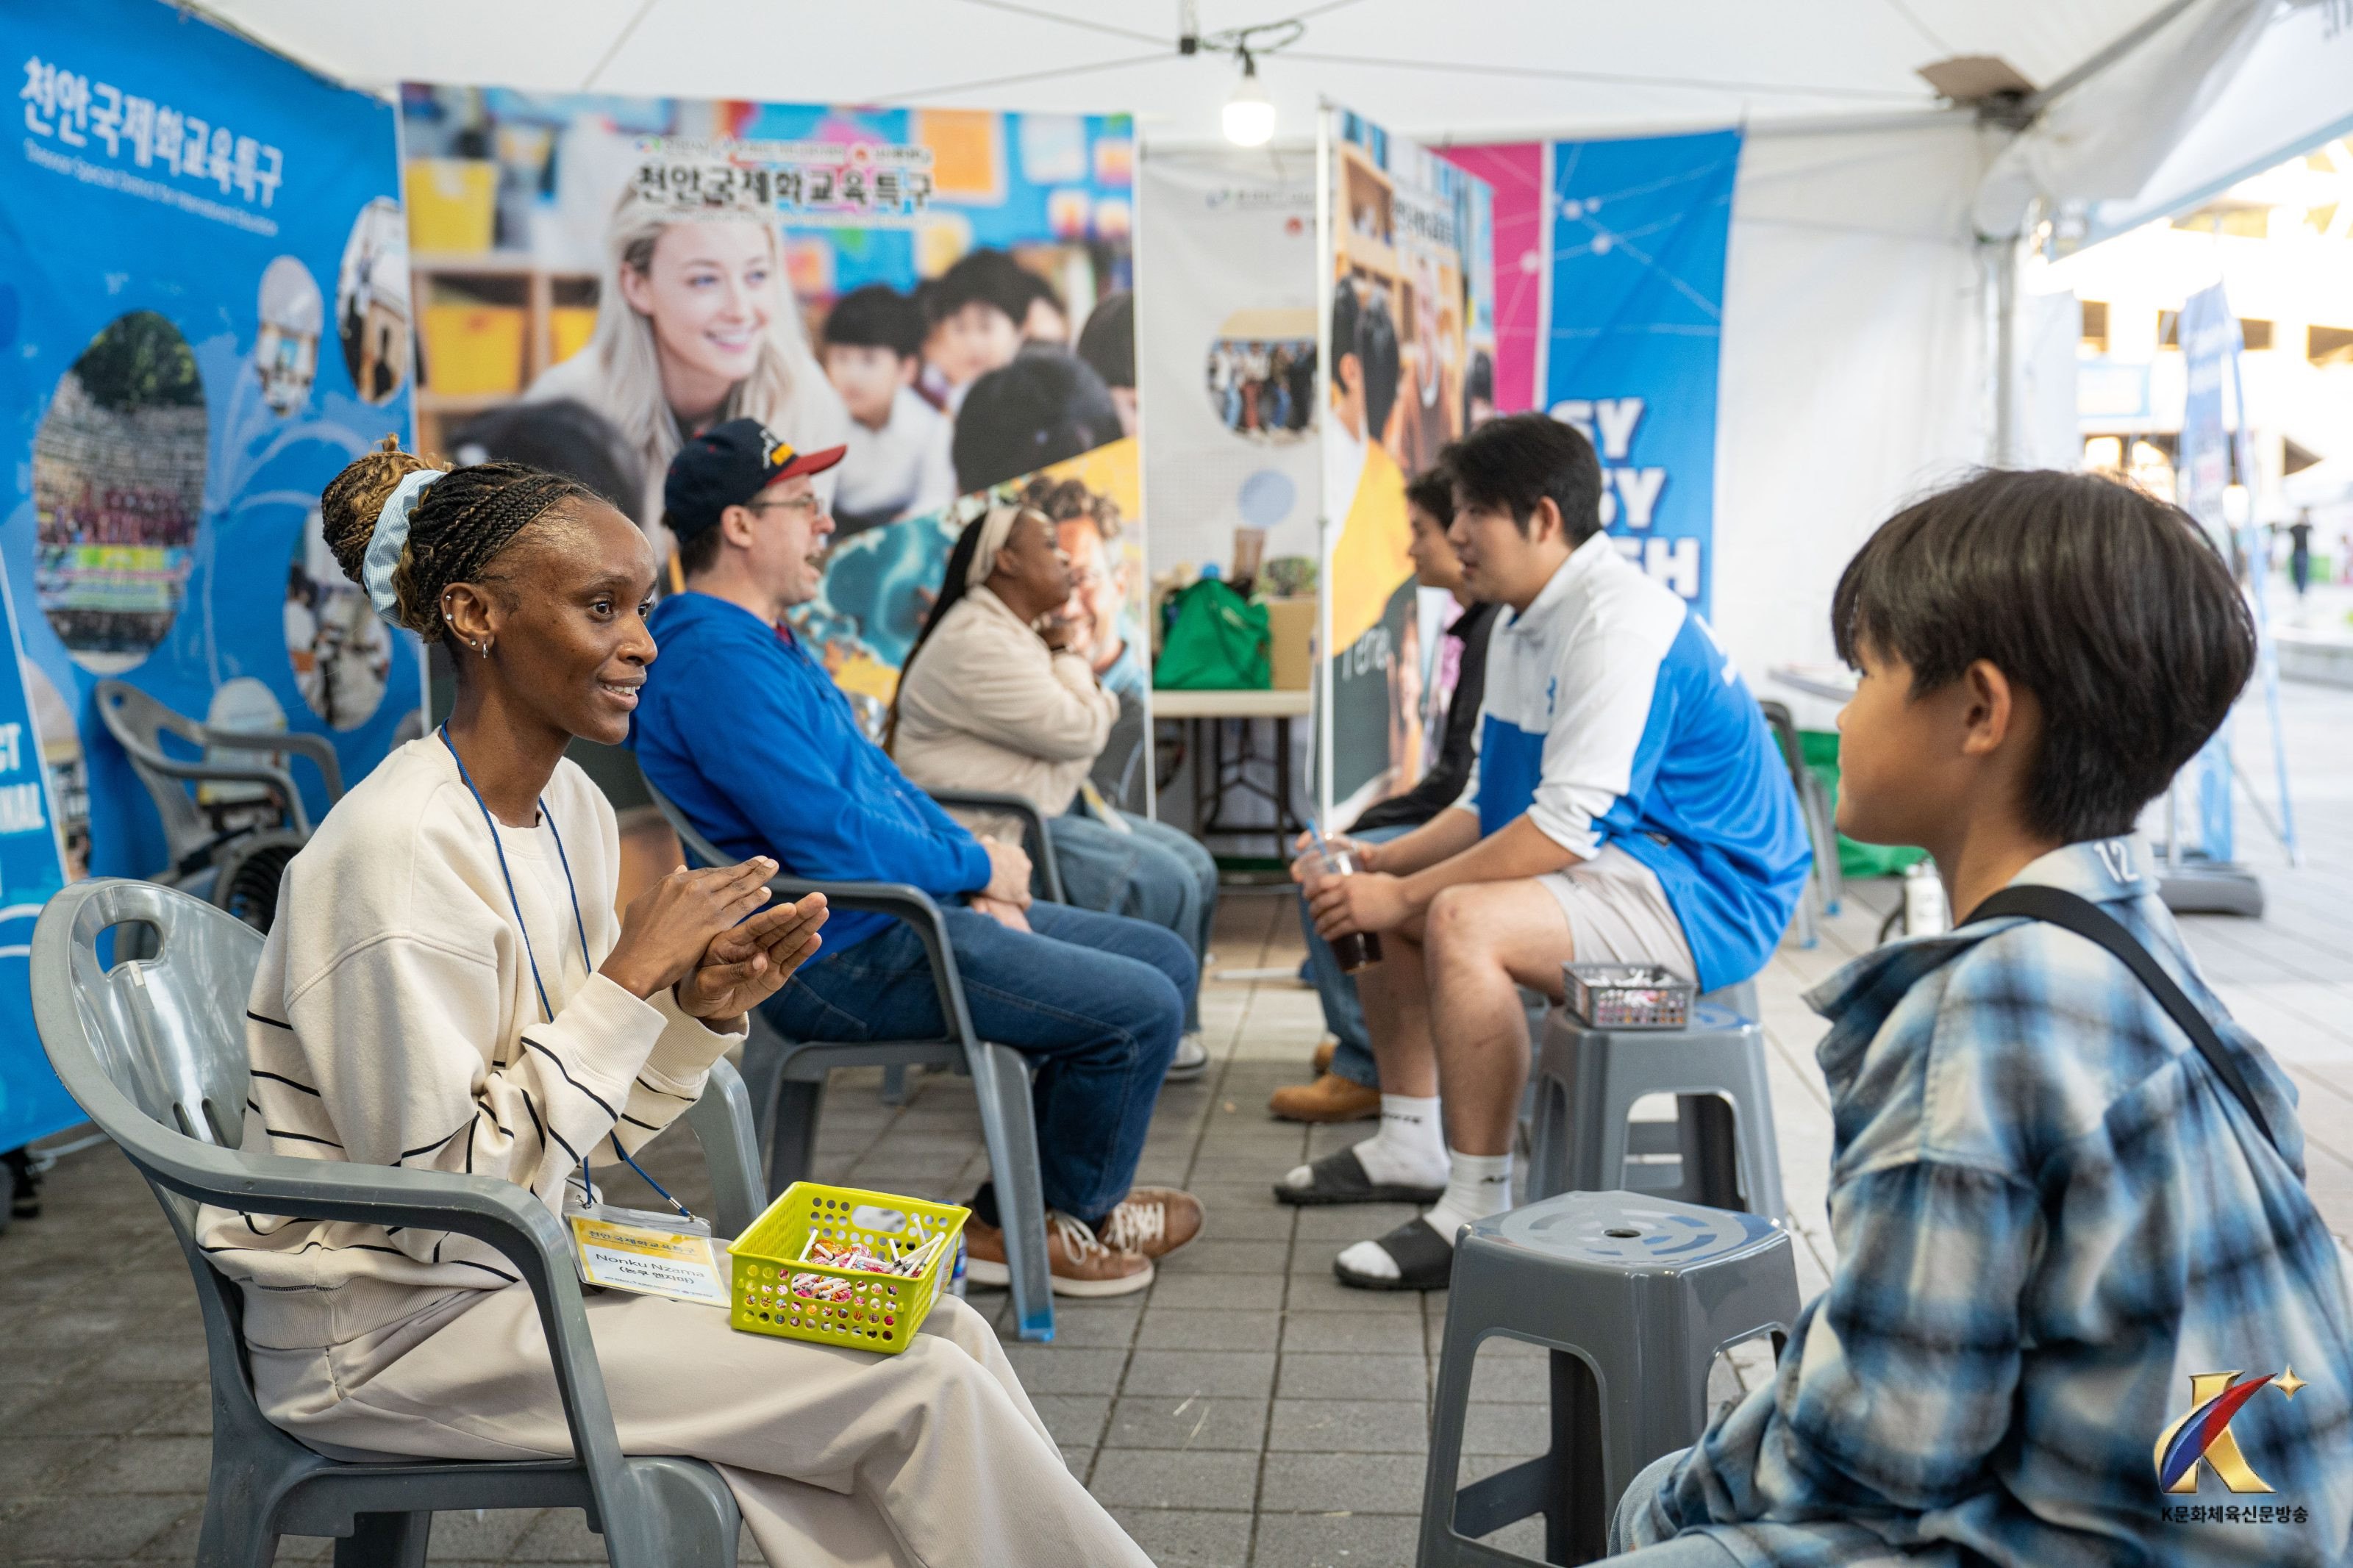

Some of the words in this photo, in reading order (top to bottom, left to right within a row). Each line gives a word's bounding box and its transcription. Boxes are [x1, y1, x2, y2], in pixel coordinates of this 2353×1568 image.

[20, 55, 283, 208] 천안국제화교육특구
[639, 165, 932, 208] 천안국제화교육특구
[596, 1253, 647, 1268] Nonku
[651, 1263, 704, 1278] Nzama
